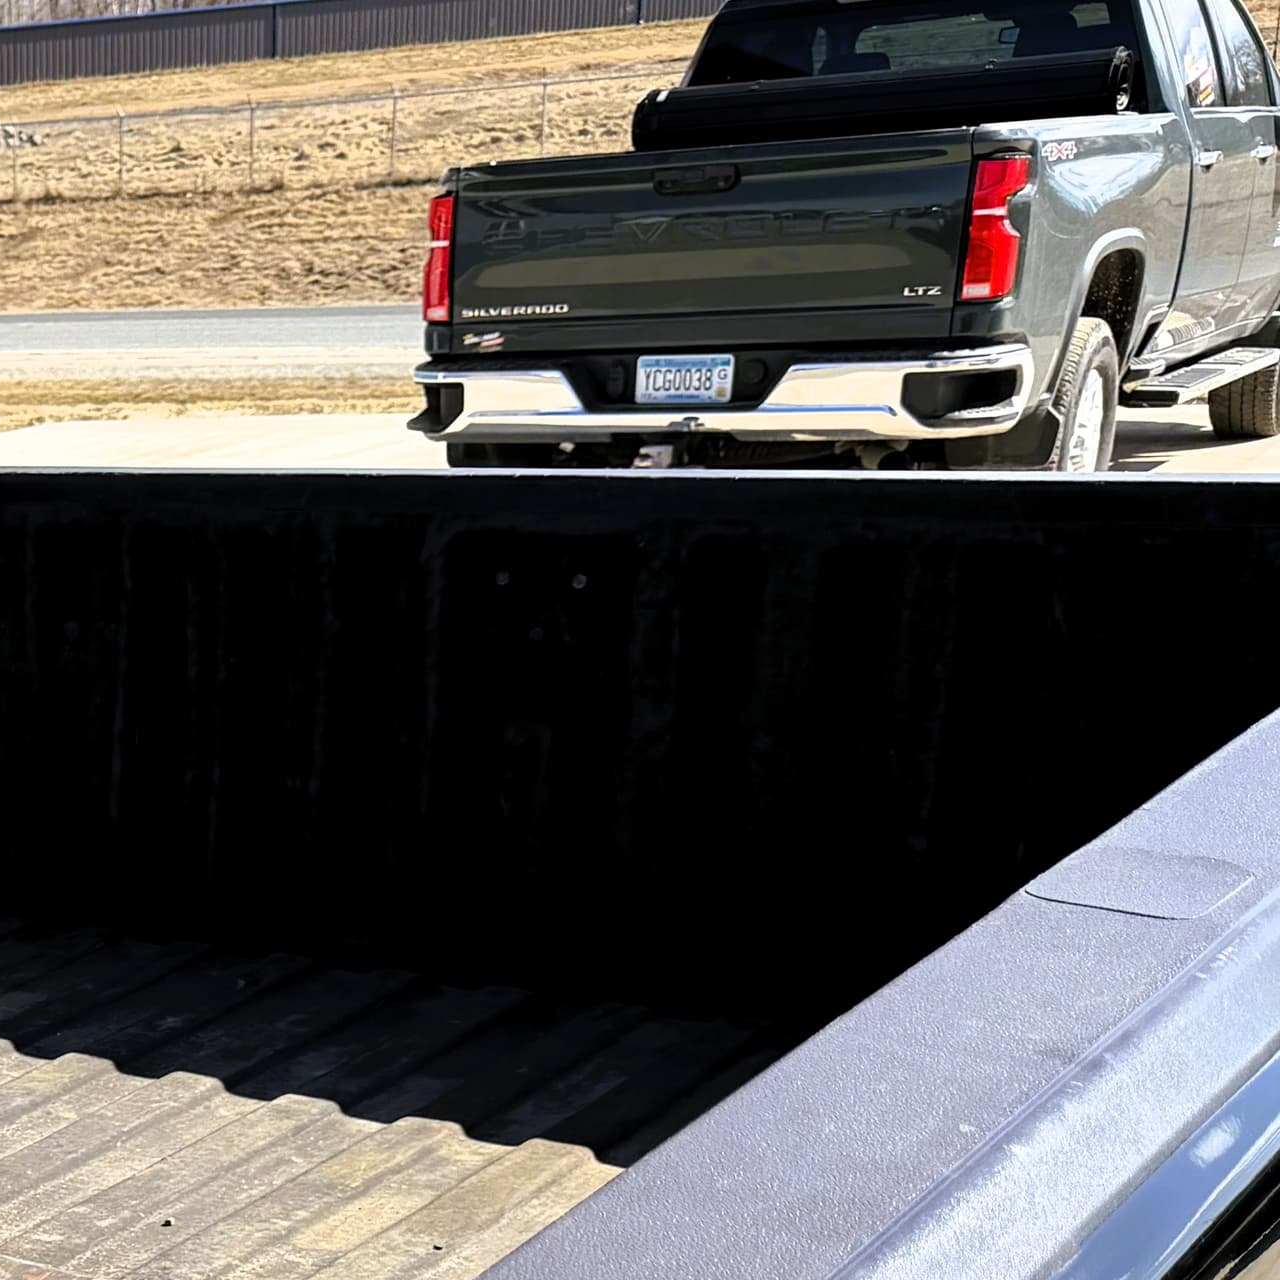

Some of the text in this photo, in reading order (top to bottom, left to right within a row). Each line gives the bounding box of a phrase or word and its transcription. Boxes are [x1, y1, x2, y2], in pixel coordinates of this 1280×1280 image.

[903, 286, 942, 296] LTZ
[461, 304, 569, 318] SILVERADO
[644, 368, 713, 391] YCG0038
